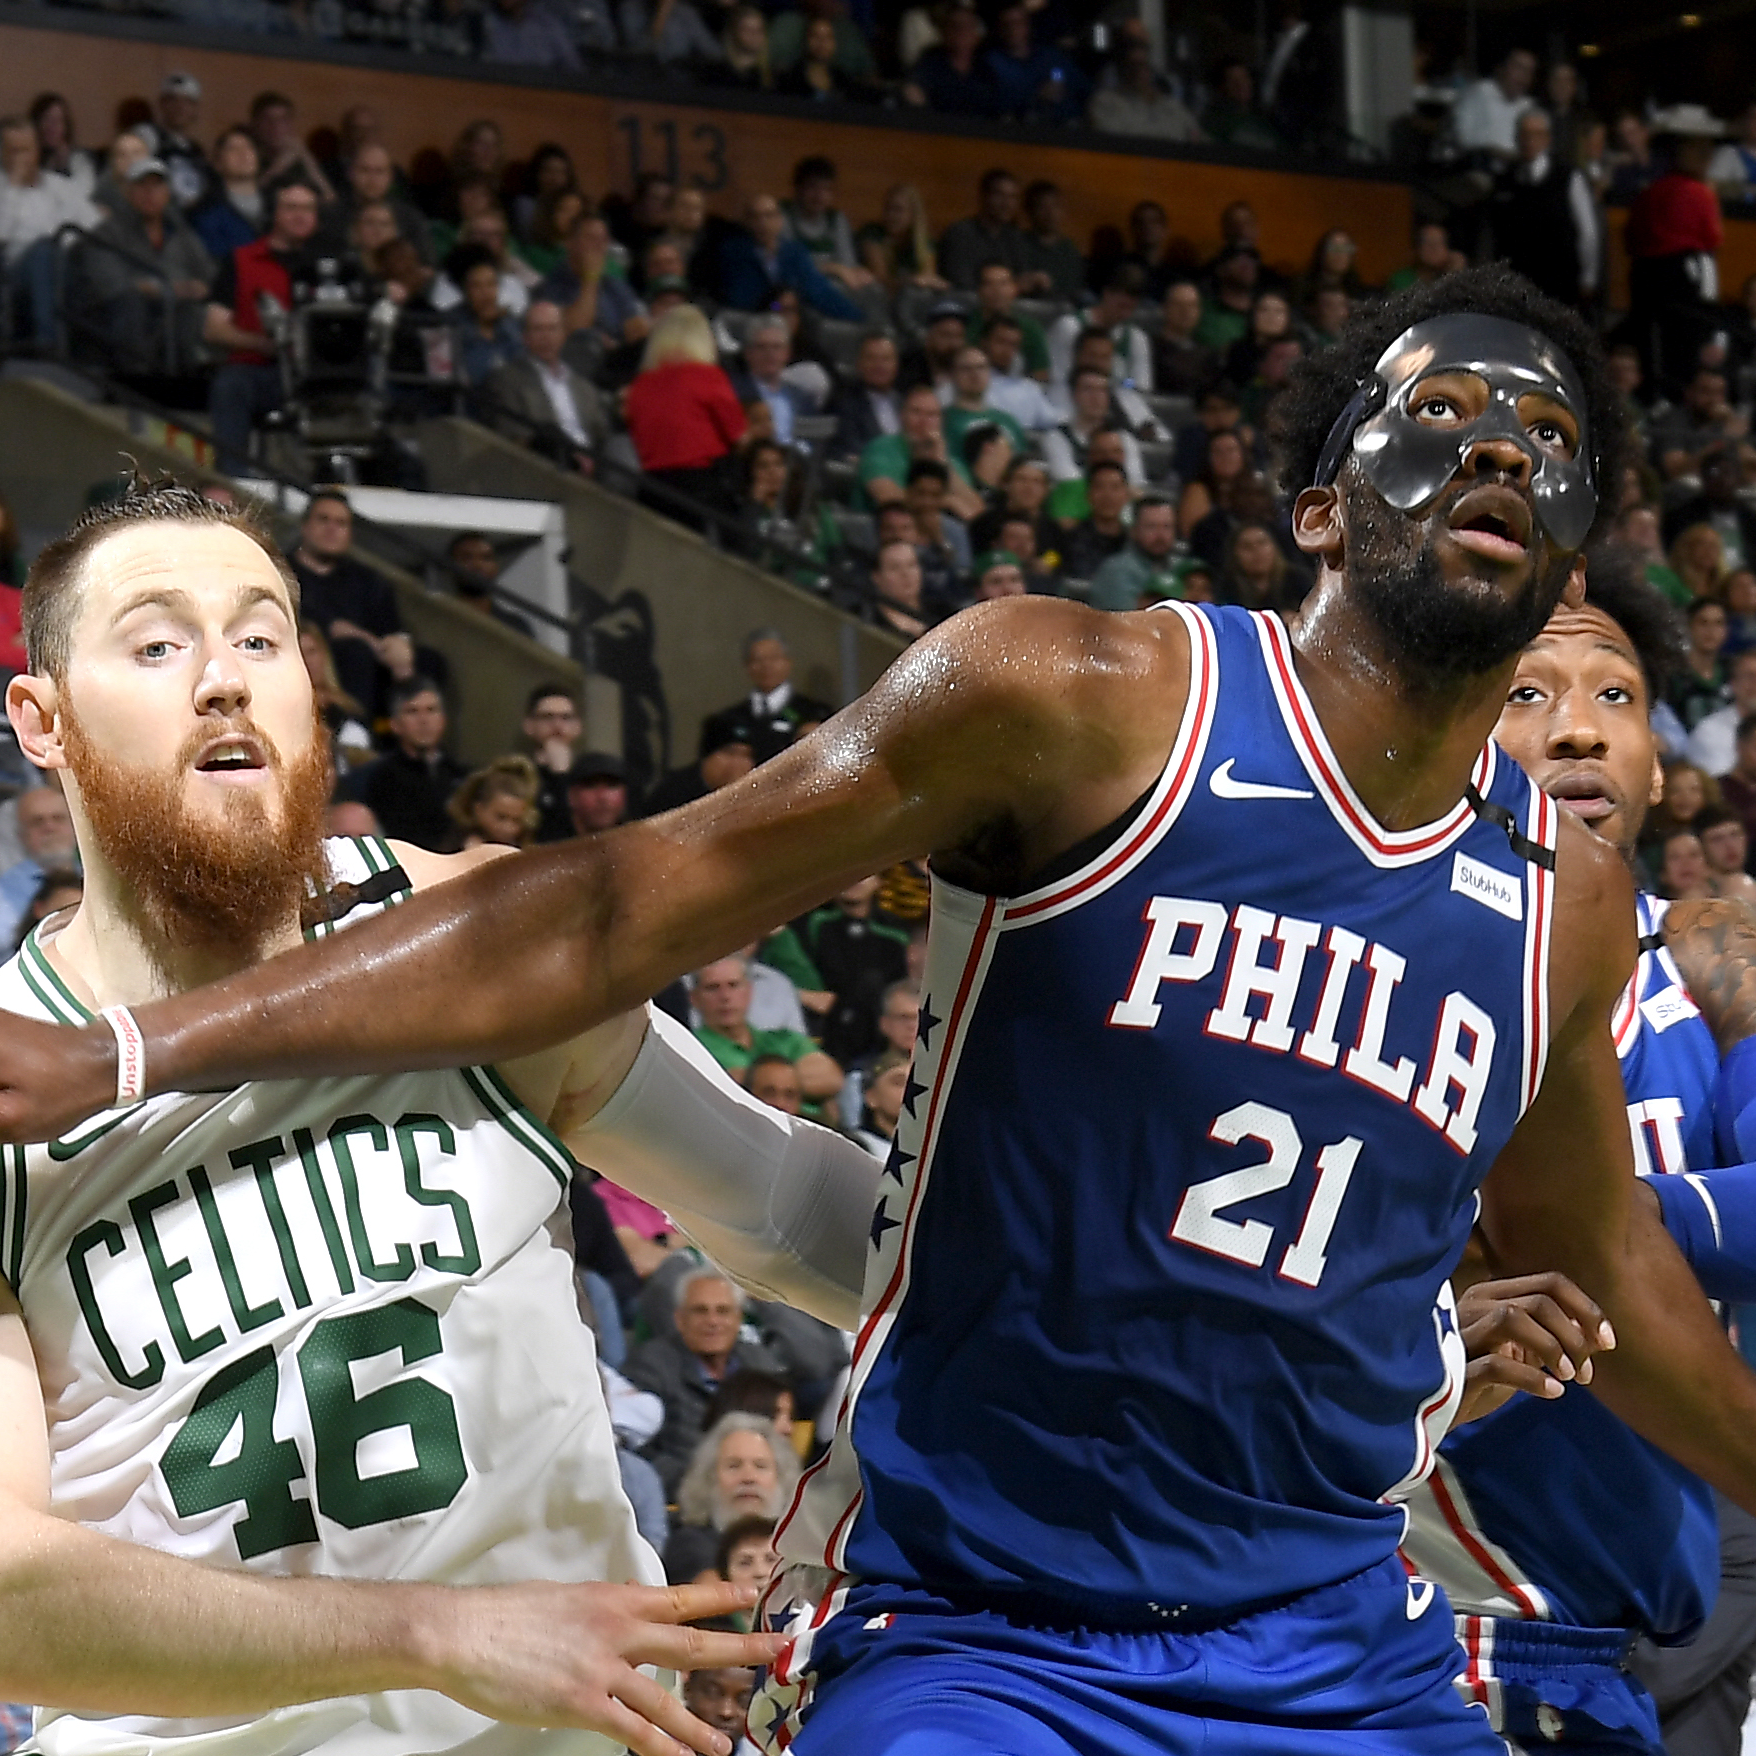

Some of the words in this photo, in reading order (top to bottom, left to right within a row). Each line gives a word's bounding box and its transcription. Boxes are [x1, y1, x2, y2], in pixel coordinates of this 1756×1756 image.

[617, 115, 728, 190] 113
[1460, 866, 1512, 903] StubHub
[1106, 895, 1498, 1156] PHILA
[66, 1112, 481, 1391] CELTICS
[1169, 1100, 1363, 1288] 21
[159, 1297, 468, 1559] 46
